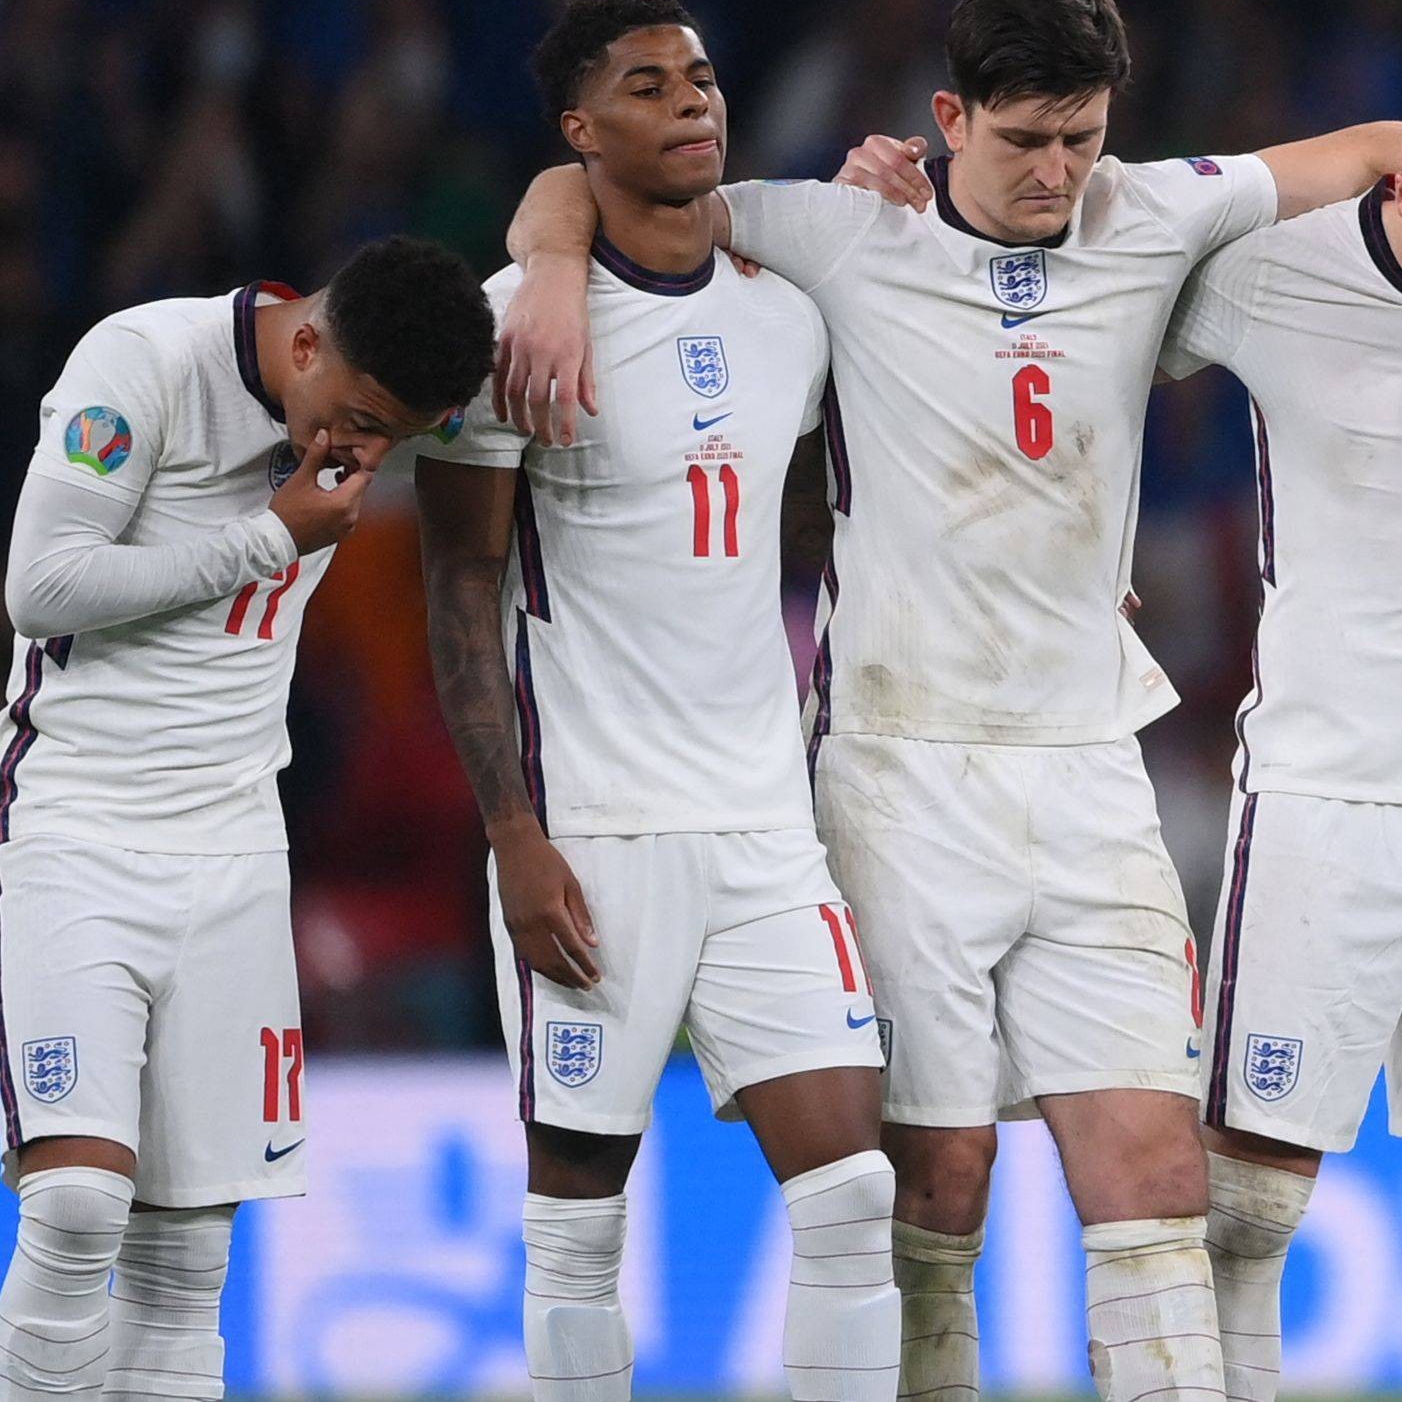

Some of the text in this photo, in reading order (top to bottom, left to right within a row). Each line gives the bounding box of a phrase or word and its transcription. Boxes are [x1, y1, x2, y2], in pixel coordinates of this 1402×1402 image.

[1012, 364, 1054, 460] 6
[685, 464, 739, 557] 11
[260, 1027, 303, 1122] 17
